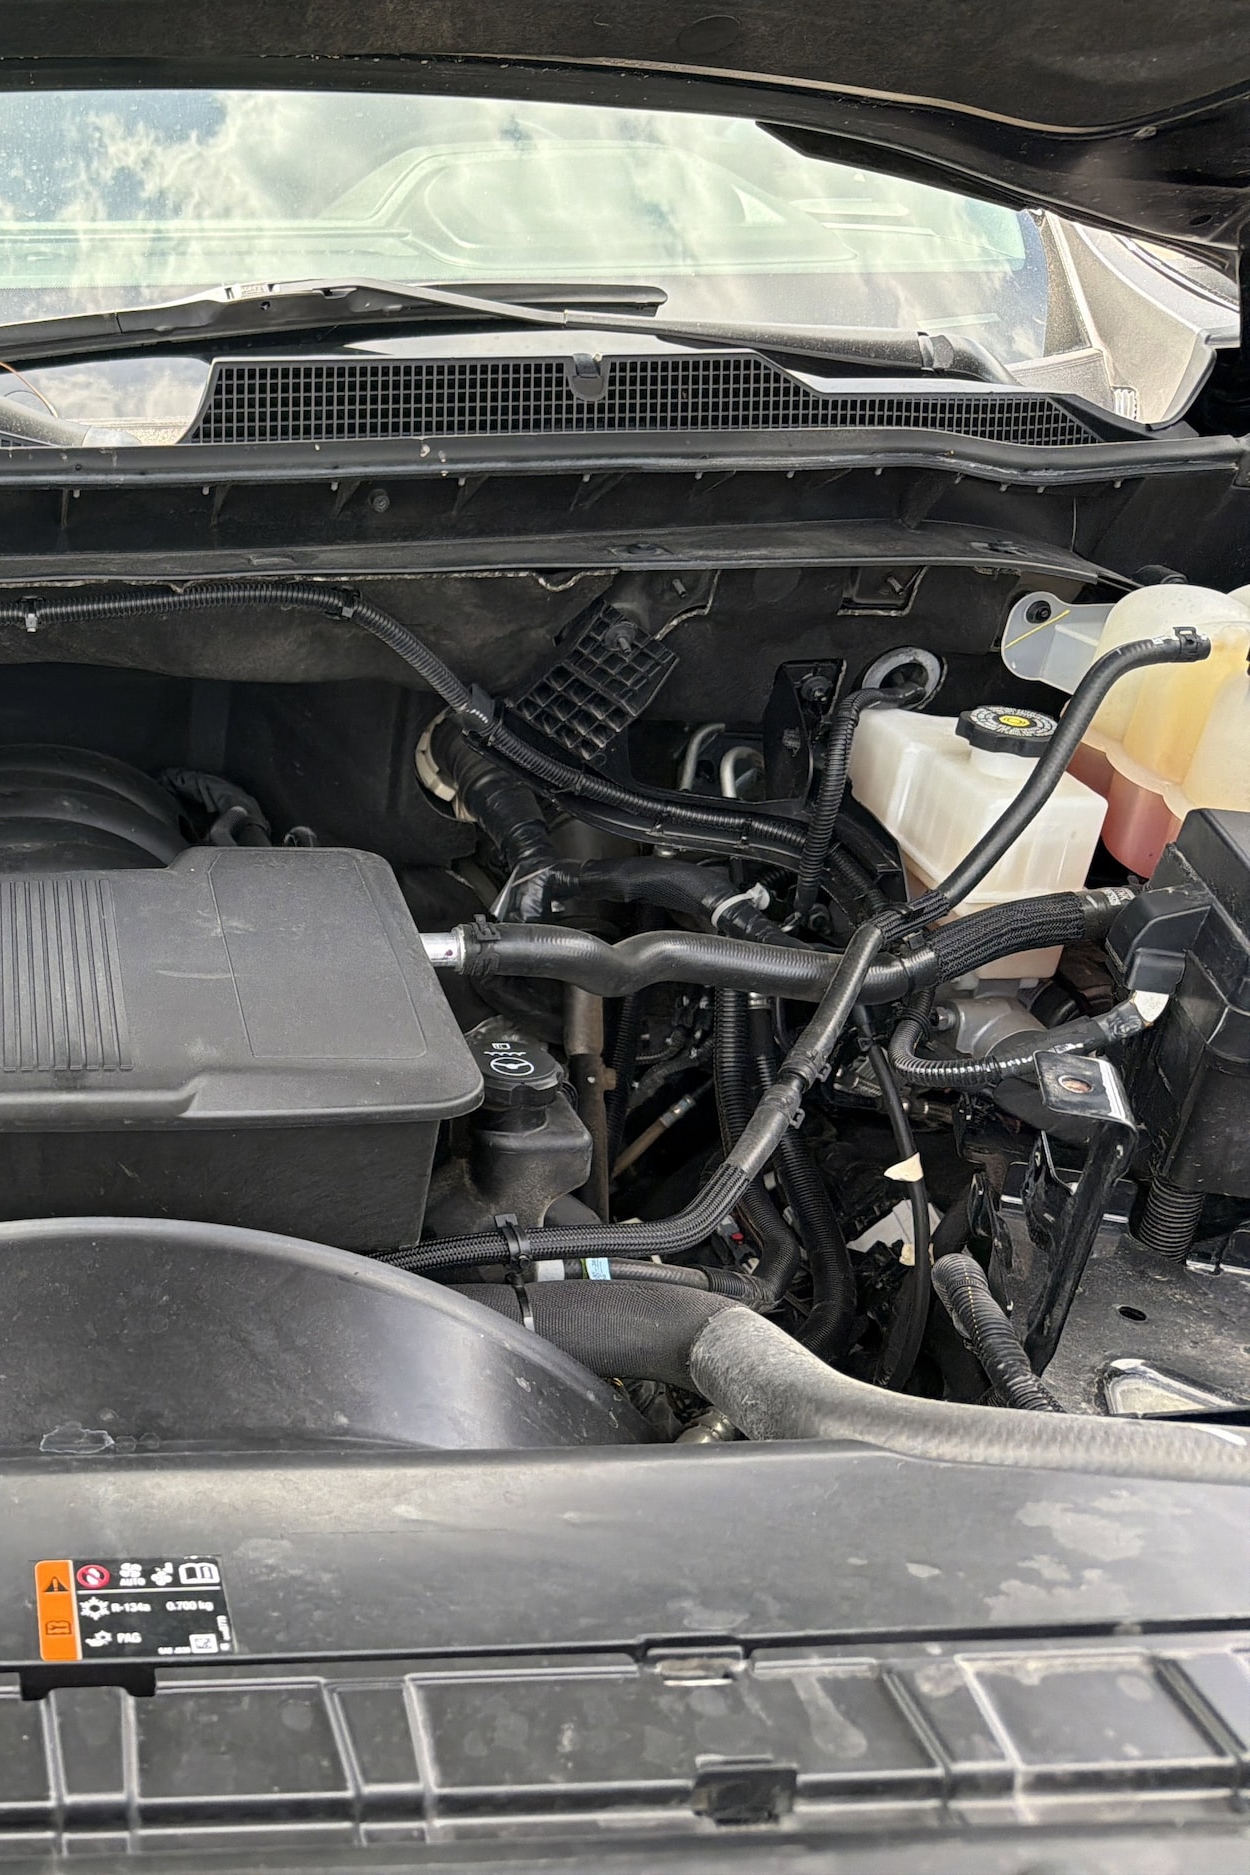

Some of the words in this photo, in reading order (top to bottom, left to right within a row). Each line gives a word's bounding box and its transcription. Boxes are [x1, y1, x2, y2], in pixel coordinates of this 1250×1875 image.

[119, 1577, 146, 1586] AUTO
[111, 1602, 151, 1612] R-134a
[166, 1600, 197, 1611] 0.700
[198, 1600, 214, 1612] kg
[117, 1632, 142, 1643] PAG
